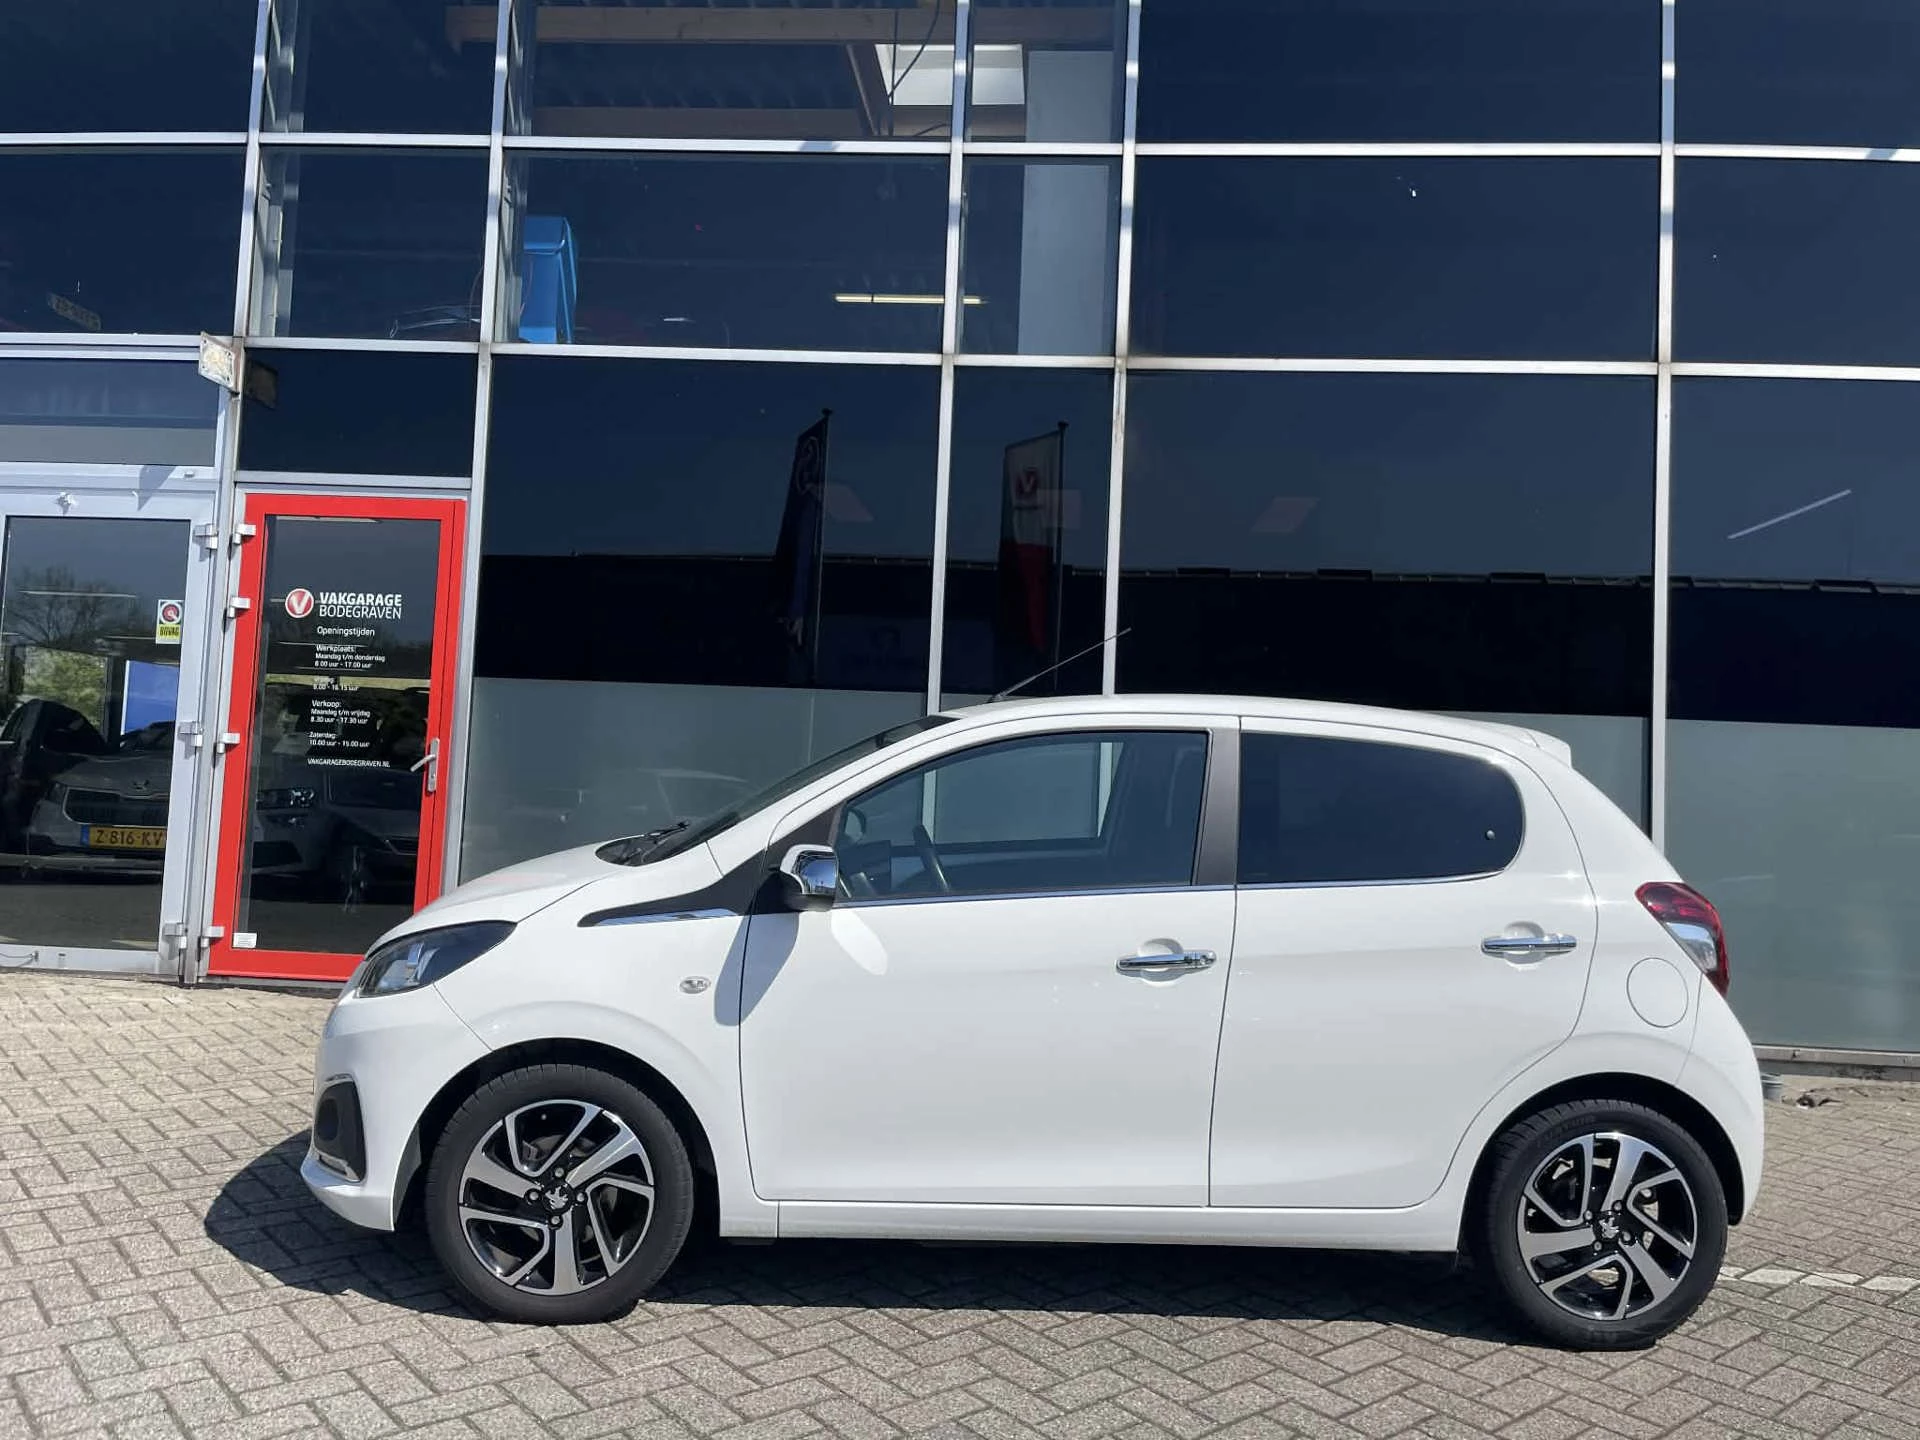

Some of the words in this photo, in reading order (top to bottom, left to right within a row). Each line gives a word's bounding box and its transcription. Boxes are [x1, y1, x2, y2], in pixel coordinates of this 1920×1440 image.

[320, 592, 402, 607] VAKGARAGE
[320, 605, 402, 619] BODEGRAVEN
[317, 626, 375, 637] Openingstijden
[315, 653, 341, 662] Maandag
[354, 653, 386, 662] donderdag
[311, 700, 342, 708] Verkoop:
[310, 709, 337, 717] Maandag
[350, 710, 371, 718] vrijdag
[307, 758, 391, 768] VAKGARAGEBODEGRAVEN.NL
